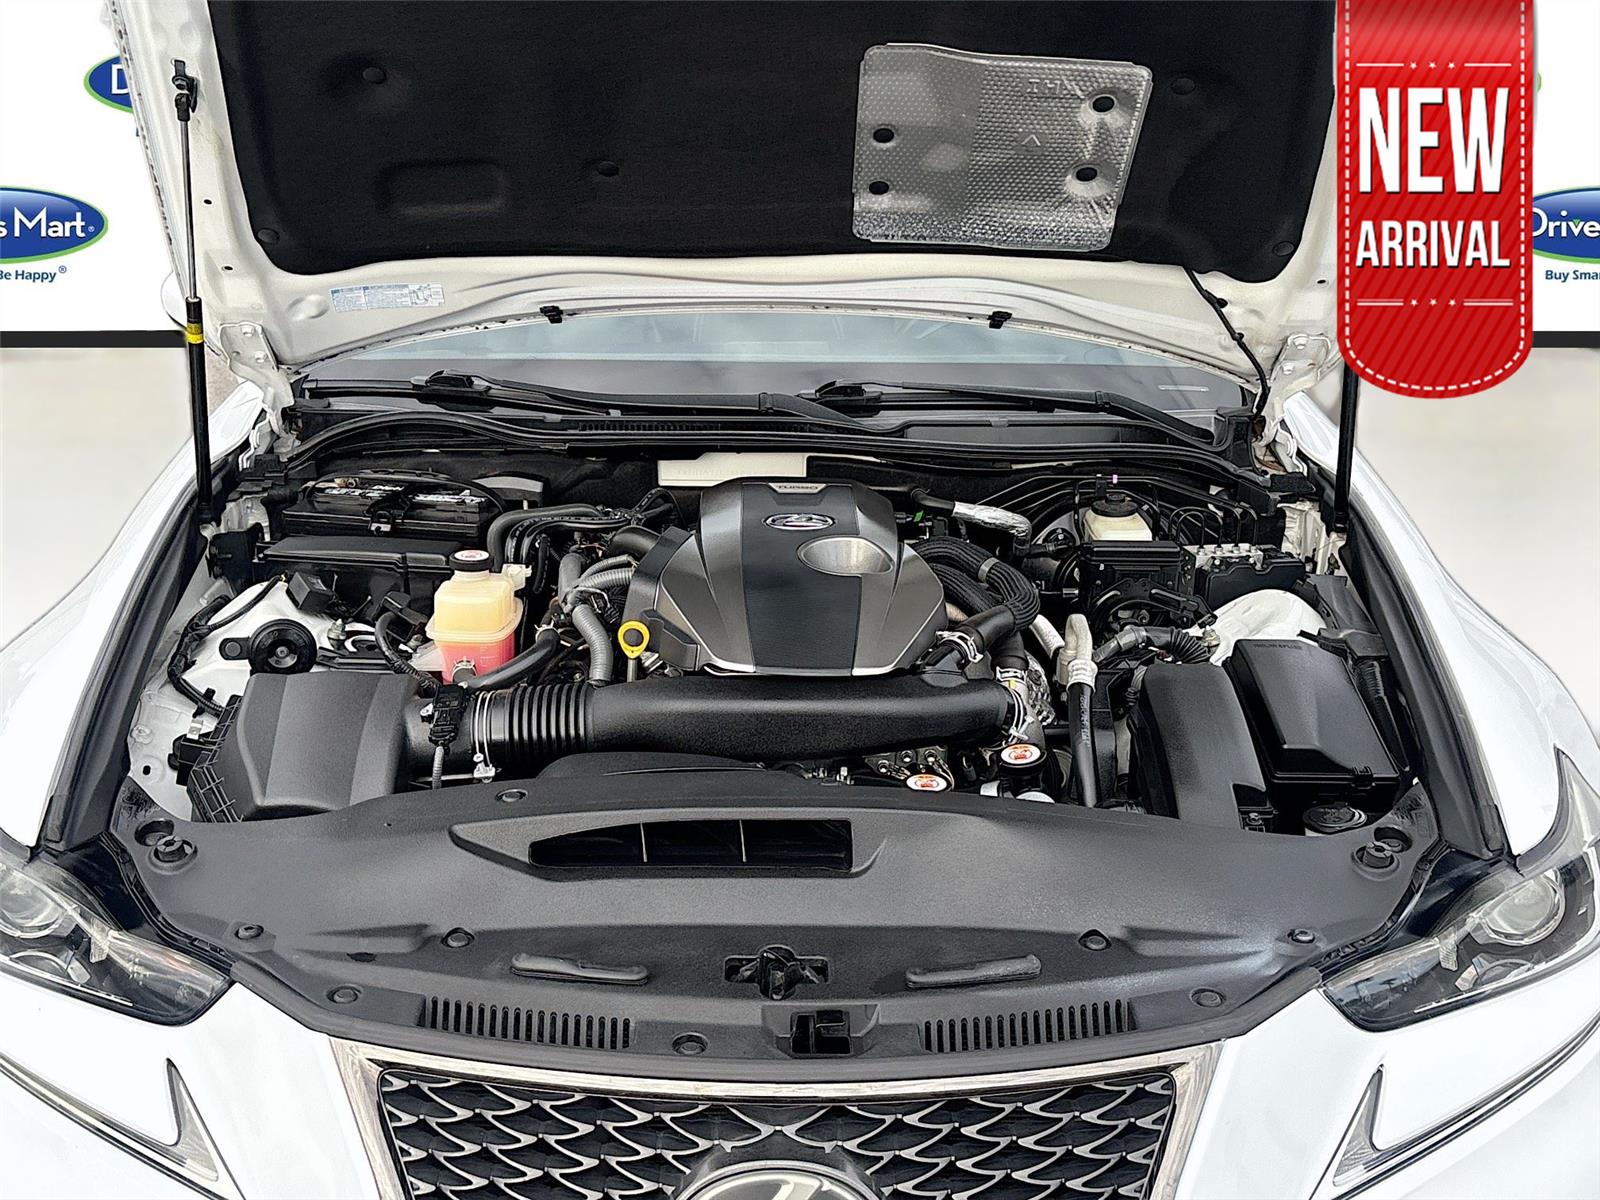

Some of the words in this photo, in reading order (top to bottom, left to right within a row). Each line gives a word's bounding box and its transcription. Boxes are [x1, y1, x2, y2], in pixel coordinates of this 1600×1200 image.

[14, 206, 86, 238] Mart
[15, 269, 57, 283] Happy
[1545, 269, 1570, 283] Buy
[1572, 269, 1600, 280] Sma
